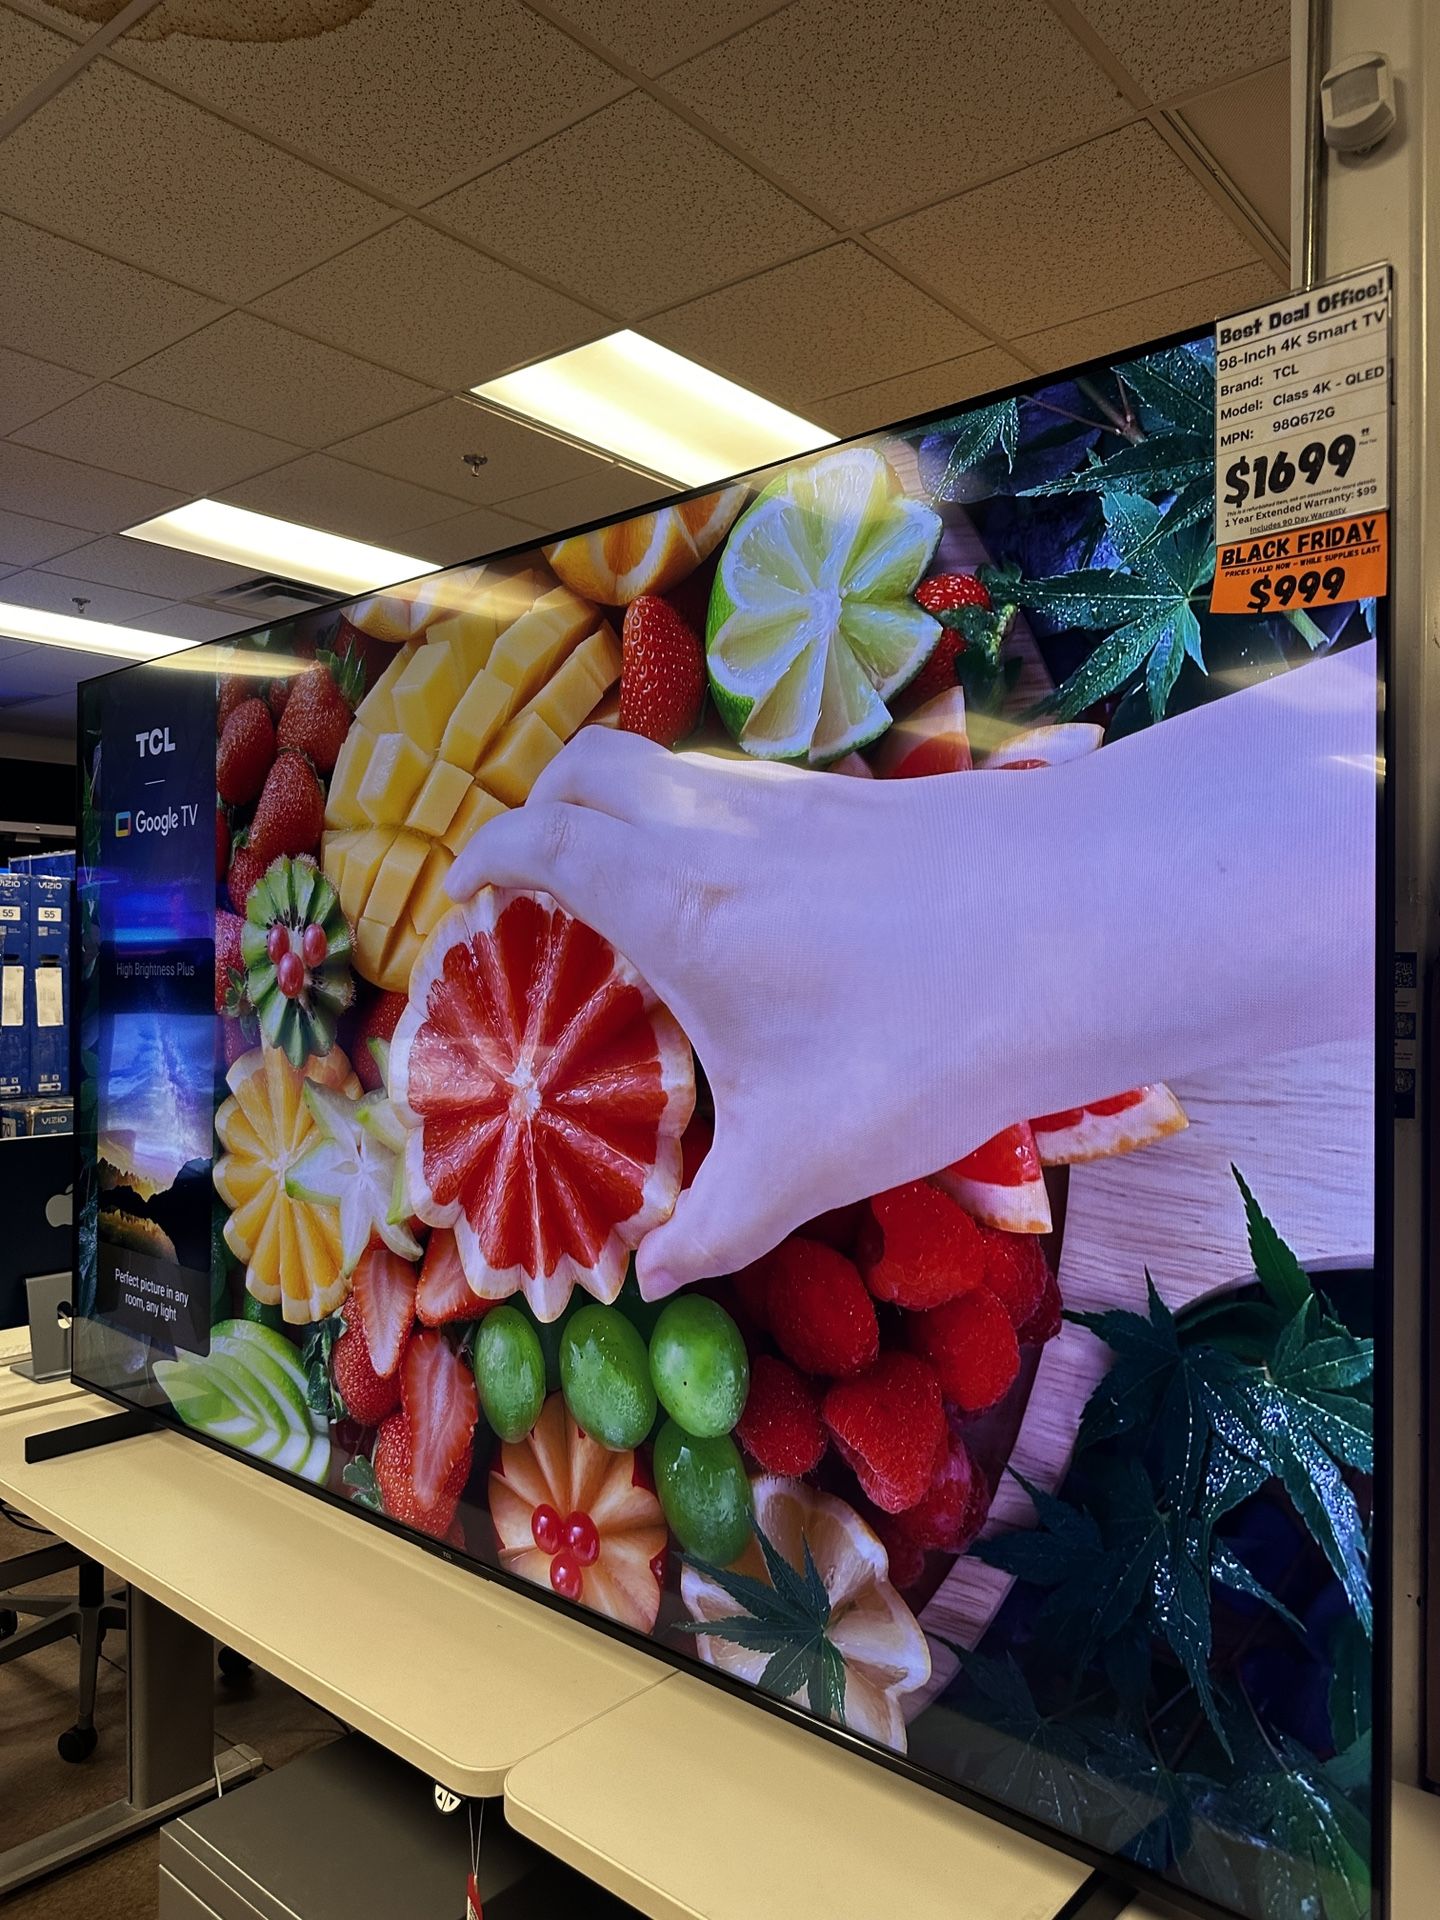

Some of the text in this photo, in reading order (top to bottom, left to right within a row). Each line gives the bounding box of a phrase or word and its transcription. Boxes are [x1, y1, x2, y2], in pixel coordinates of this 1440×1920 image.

[1221, 277, 1384, 345] Best Deal Office!
[1219, 309, 1386, 371] 98-Inch 4K Smart TV
[1221, 364, 1299, 396] Brand: TCL
[1221, 400, 1263, 420] Model:
[1273, 391, 1308, 406] Class
[1313, 381, 1331, 395] 4K
[1345, 366, 1384, 386] QLED
[1221, 407, 1335, 447] MPN: 98Q672G
[1224, 434, 1356, 508] $1699
[1225, 485, 1377, 527] 1 Year Extended Warranty: $99
[1250, 522, 1280, 533] Includes
[1295, 515, 1309, 524] Day
[1311, 507, 1346, 519] Warranty
[1221, 519, 1376, 567] BLACK FRIDAY
[1225, 568, 1250, 578] PRICES
[1252, 565, 1273, 574] VALID
[1275, 562, 1291, 571] NOW
[1300, 557, 1322, 567] WHILE
[1325, 551, 1359, 563] SUPPLIES
[1361, 545, 1381, 555] LAST
[1247, 566, 1345, 613] $999
[136, 726, 176, 758] TCL
[135, 803, 198, 836] Google TV
[38, 881, 62, 889] VIZIO
[2, 909, 14, 917] 55
[44, 910, 55, 918] 55
[116, 961, 195, 979] High Brightness Plus
[42, 1115, 67, 1124] VIZIO
[115, 1268, 189, 1308] Perfect picture in any
[125, 1293, 177, 1321] room, any light
